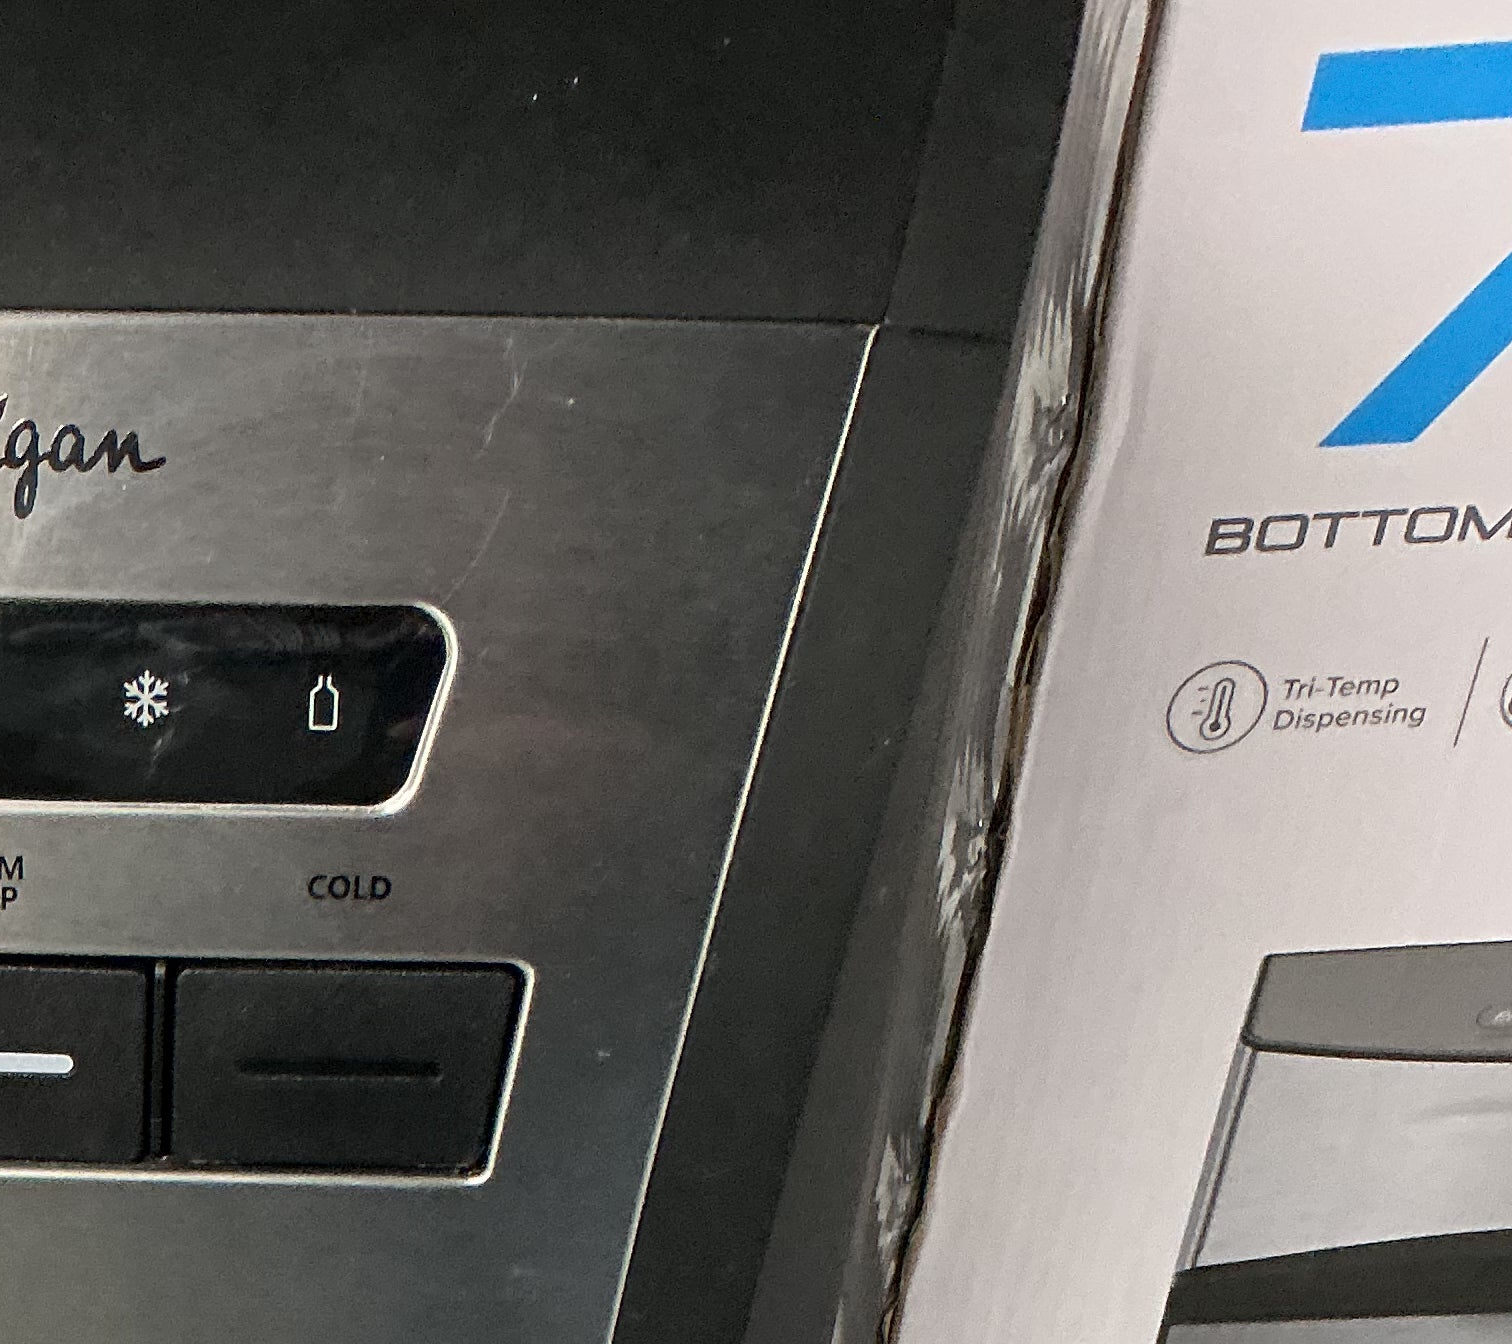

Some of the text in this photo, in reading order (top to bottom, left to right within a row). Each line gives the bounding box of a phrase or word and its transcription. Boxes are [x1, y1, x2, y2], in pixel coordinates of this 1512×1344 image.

[1205, 504, 1512, 556] BOTTOM
[1282, 676, 1400, 701] Tri-Temp
[1272, 704, 1427, 733] Dispensing
[306, 874, 392, 902] COLD
